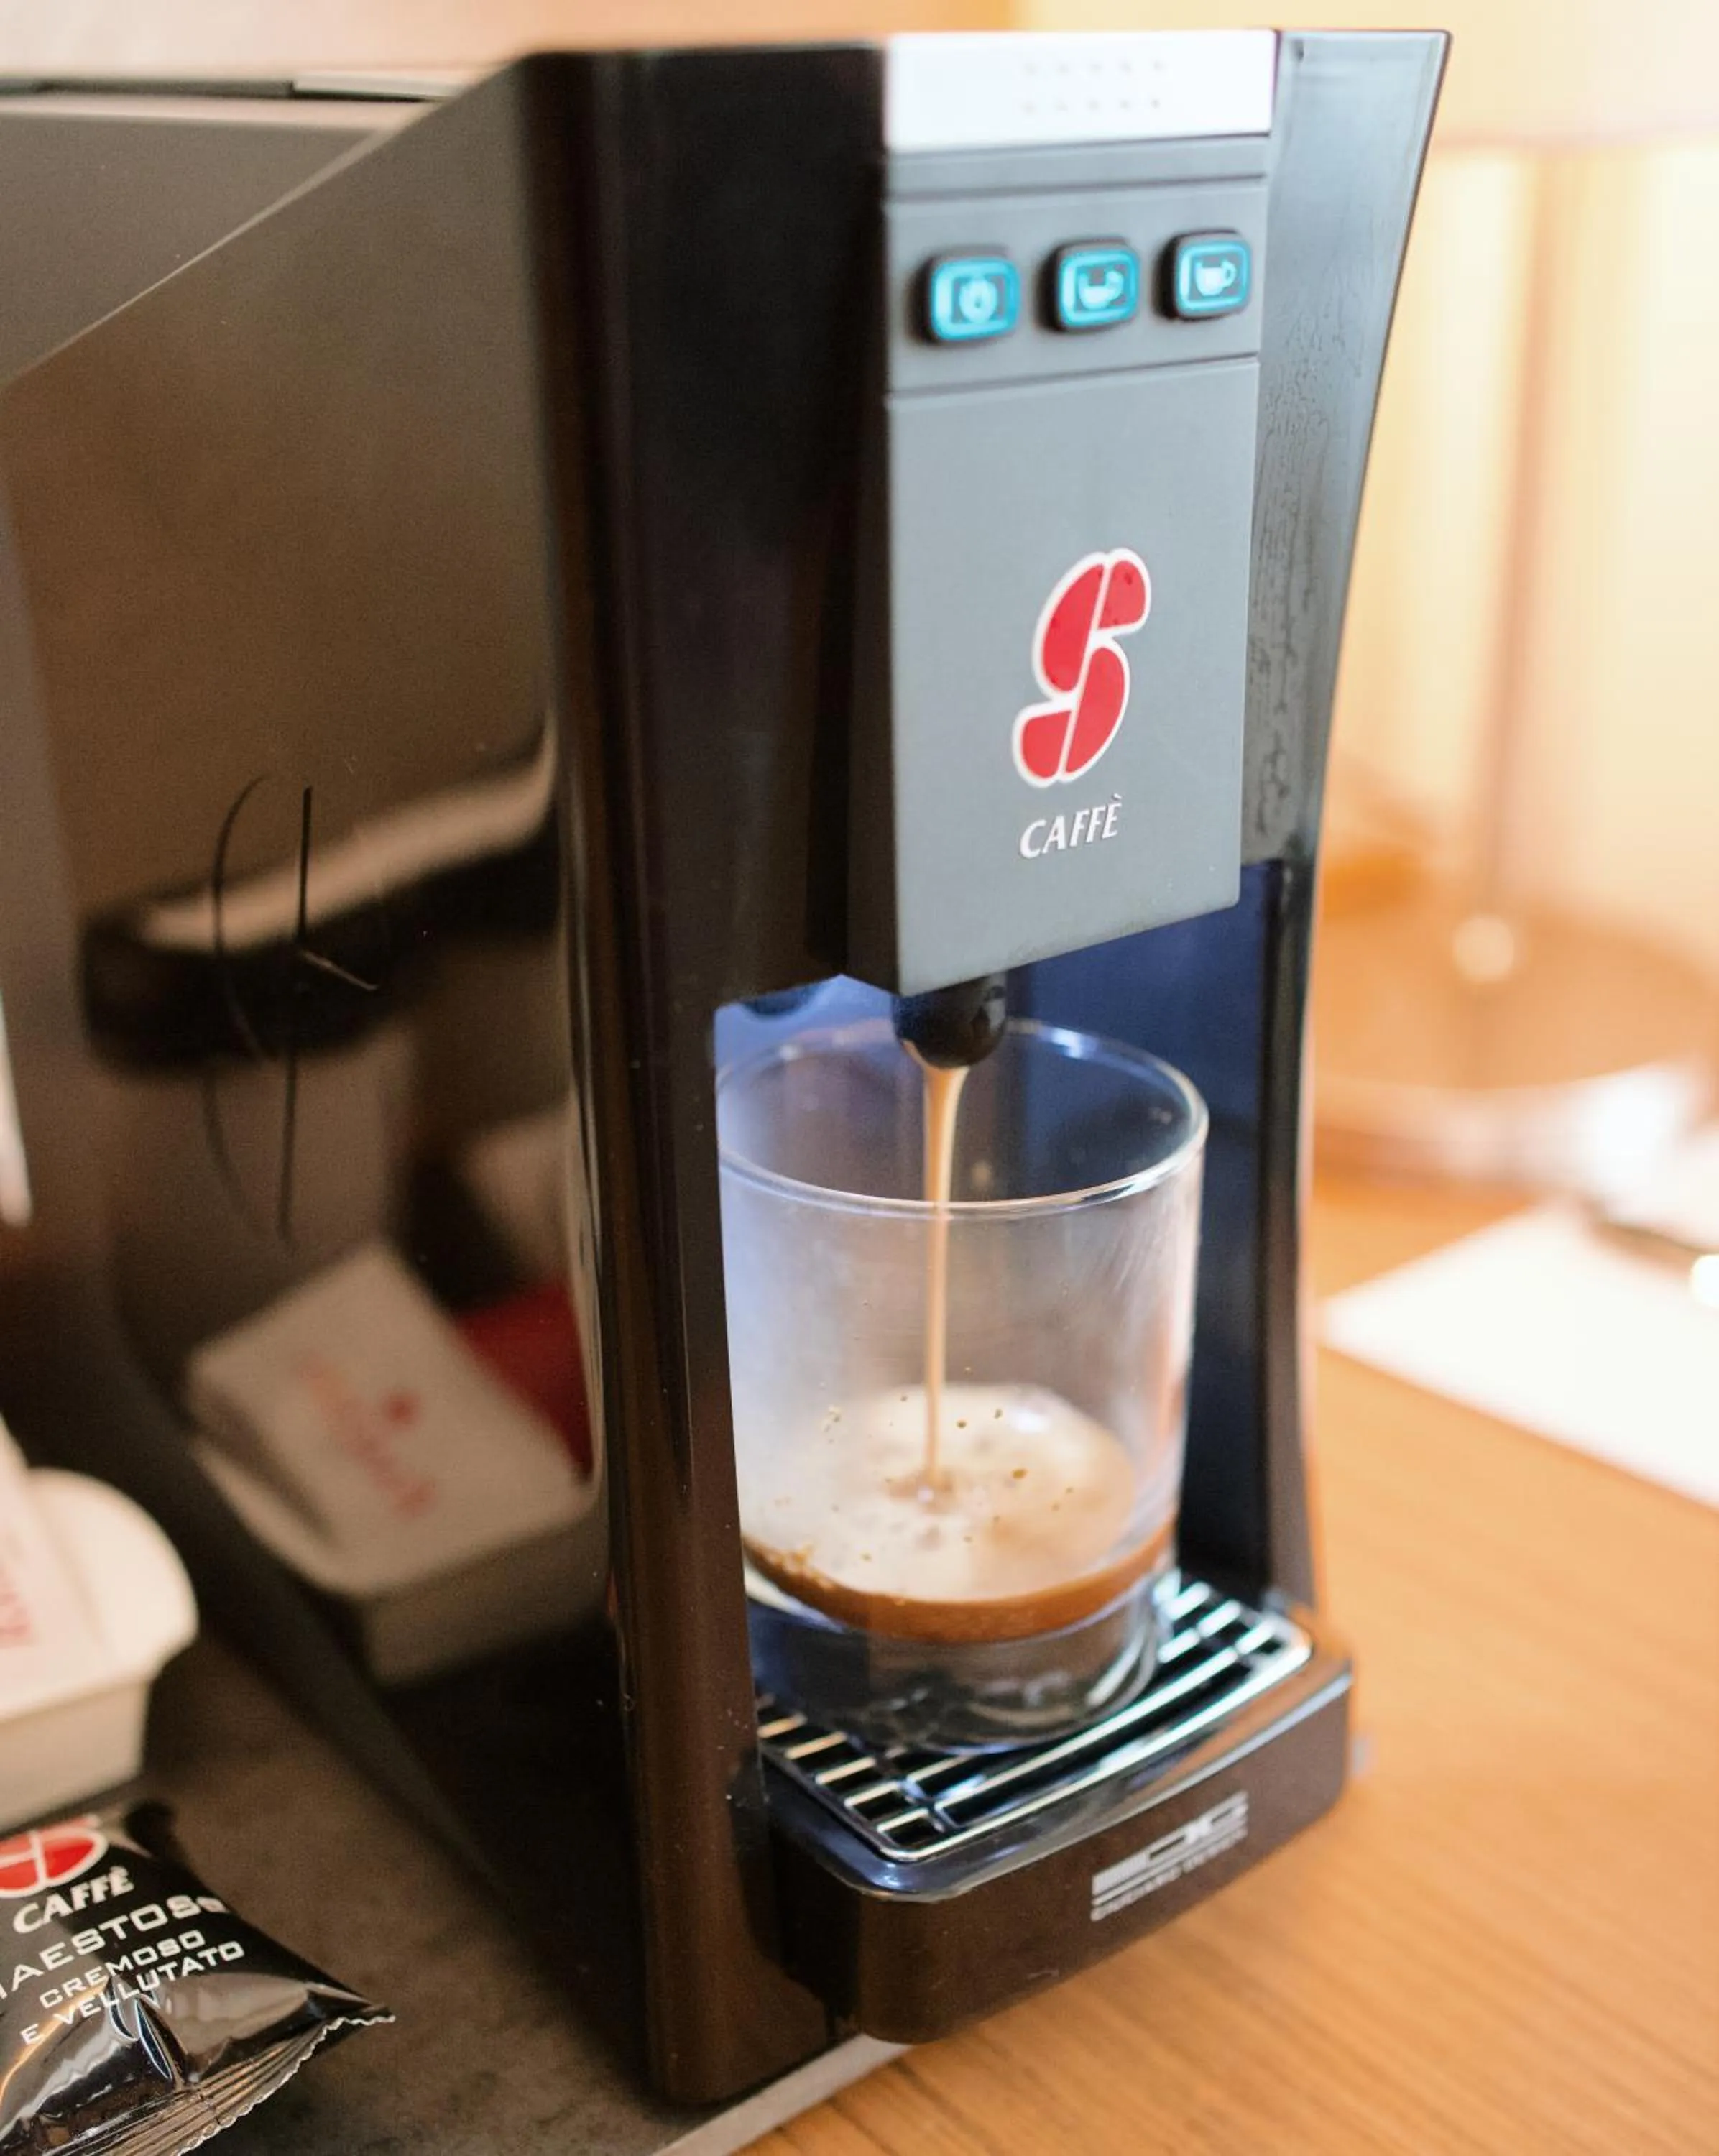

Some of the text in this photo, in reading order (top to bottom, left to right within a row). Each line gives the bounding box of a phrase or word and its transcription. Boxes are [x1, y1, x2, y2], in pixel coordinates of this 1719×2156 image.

[1020, 793, 1123, 860] CAFFÈ
[0, 1894, 229, 1999] AESTOSO
[40, 1930, 206, 2009] CREMOSO
[20, 1941, 245, 2045] E VELLUTATO
